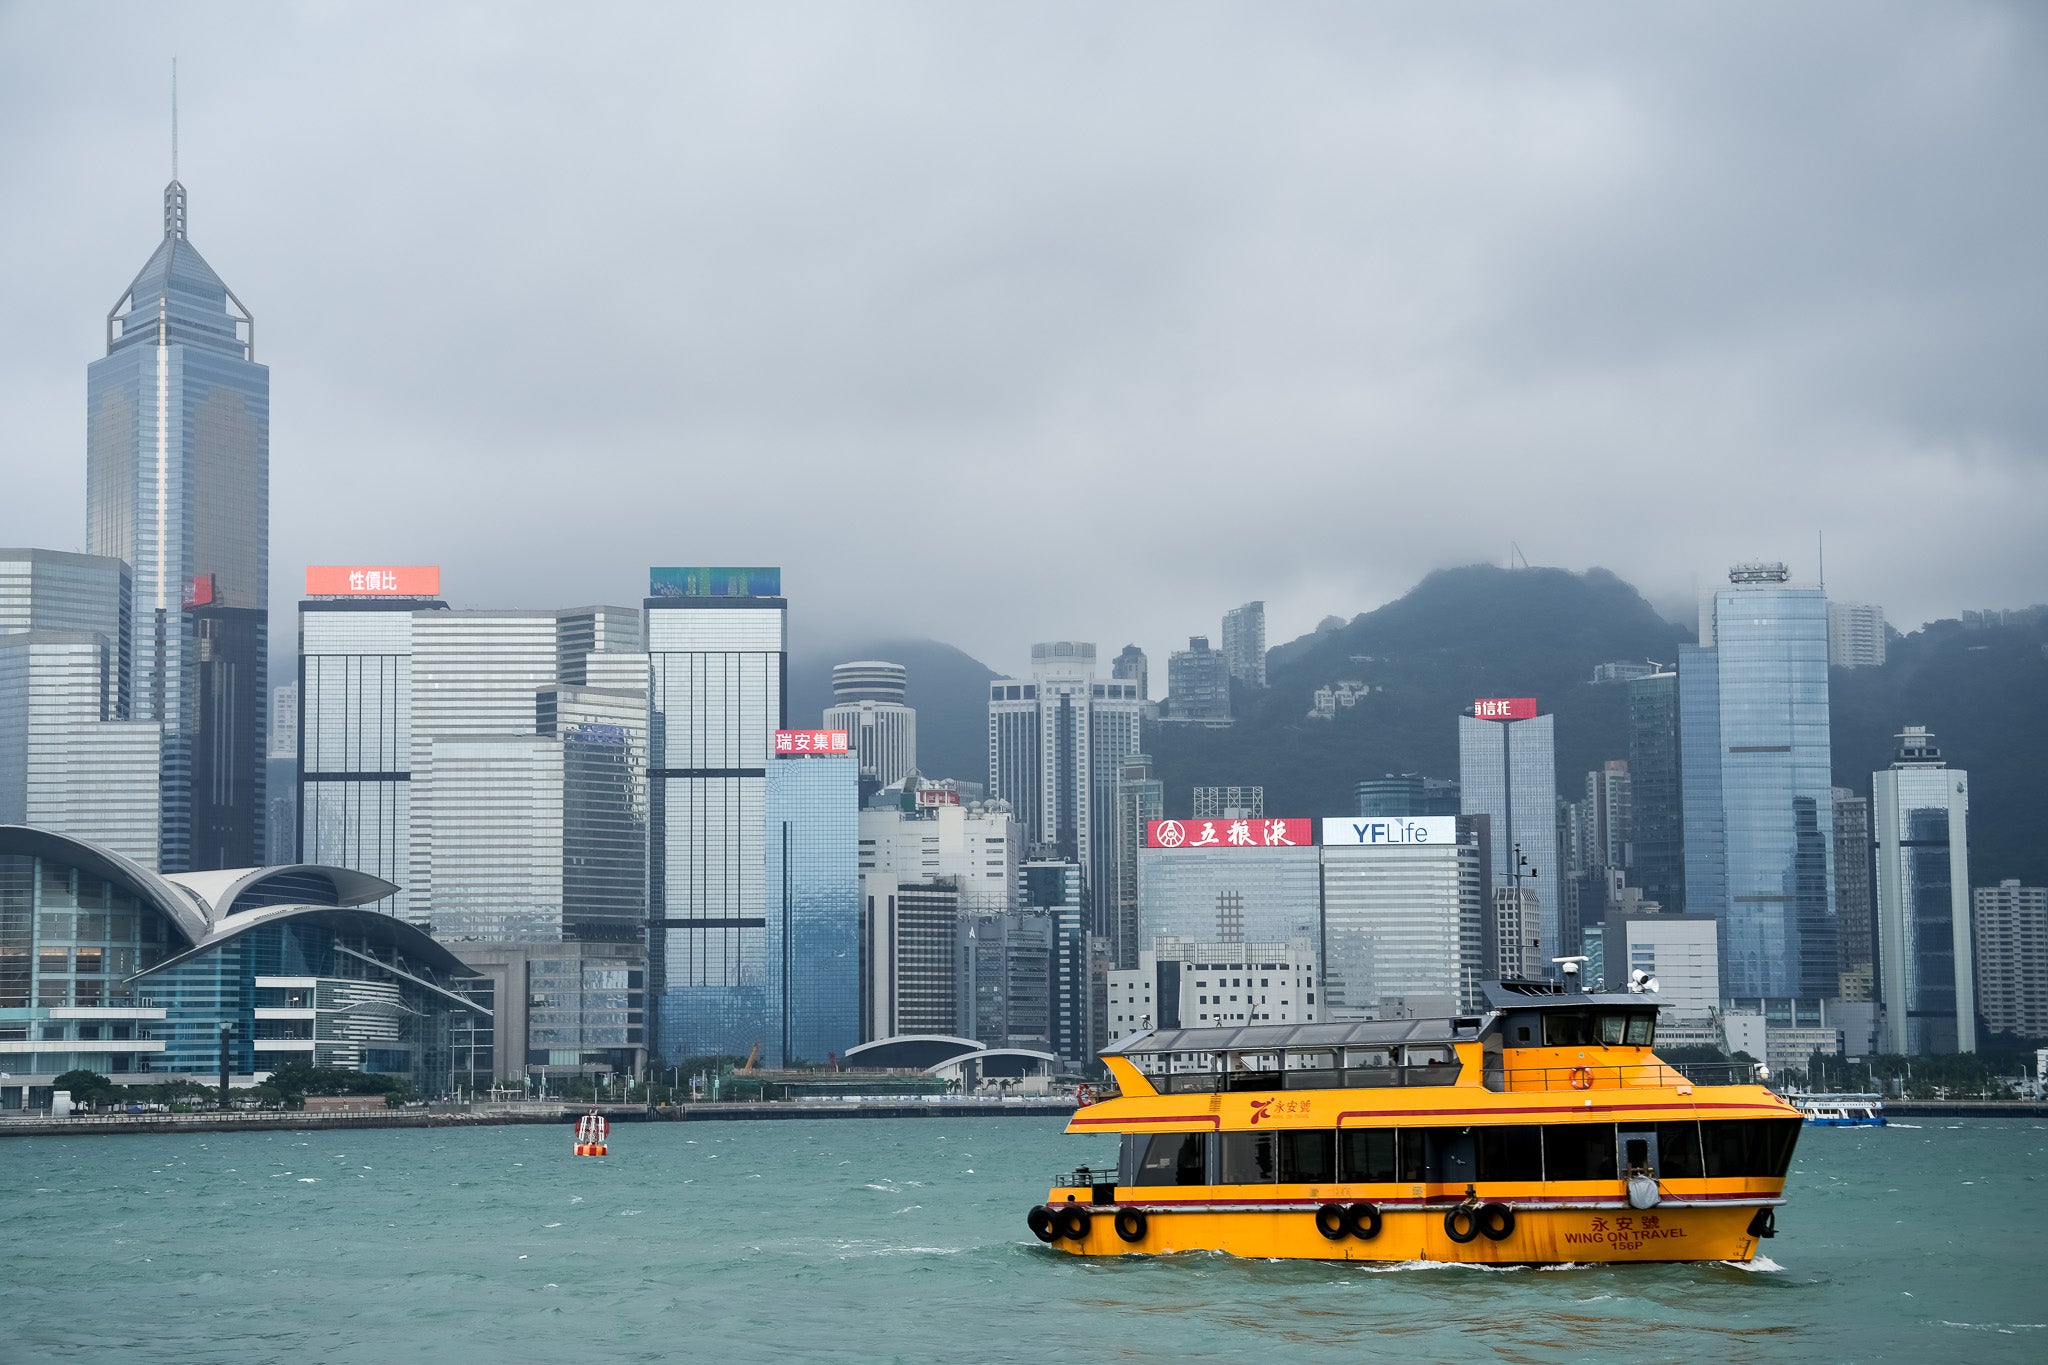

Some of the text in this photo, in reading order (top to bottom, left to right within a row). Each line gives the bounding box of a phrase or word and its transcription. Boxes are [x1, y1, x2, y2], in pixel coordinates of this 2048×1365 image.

[349, 570, 397, 591] 性價比
[776, 733, 848, 751] 瑞安集團
[1352, 818, 1428, 843] YFLife
[1591, 1215, 1660, 1232] 永安號
[1564, 1228, 1688, 1244] WING ON TRAVEL
[1611, 1241, 1644, 1251] 156P
